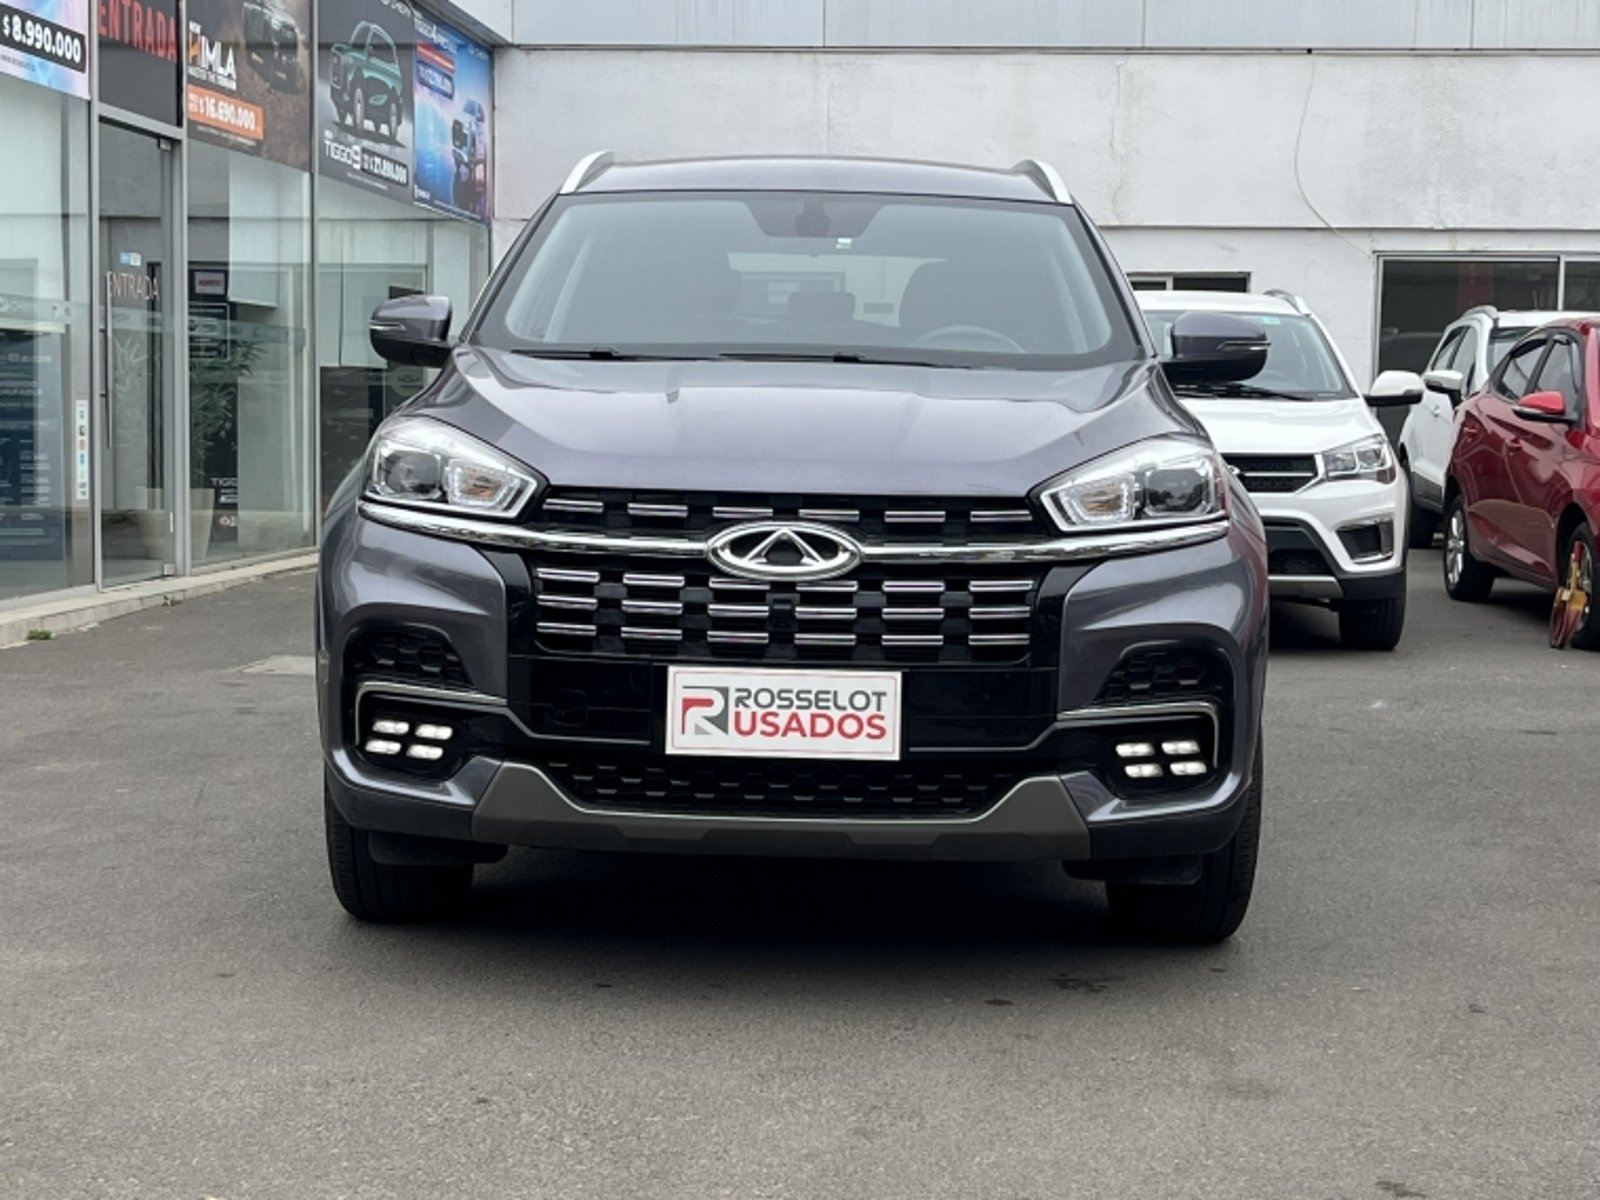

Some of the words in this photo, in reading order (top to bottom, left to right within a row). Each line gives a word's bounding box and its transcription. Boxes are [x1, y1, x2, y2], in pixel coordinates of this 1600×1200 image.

[97, 0, 177, 64] ENTRADA
[106, 271, 160, 301] ENTRADA
[734, 688, 887, 712] ROSSELOT
[734, 711, 887, 740] USADOS
